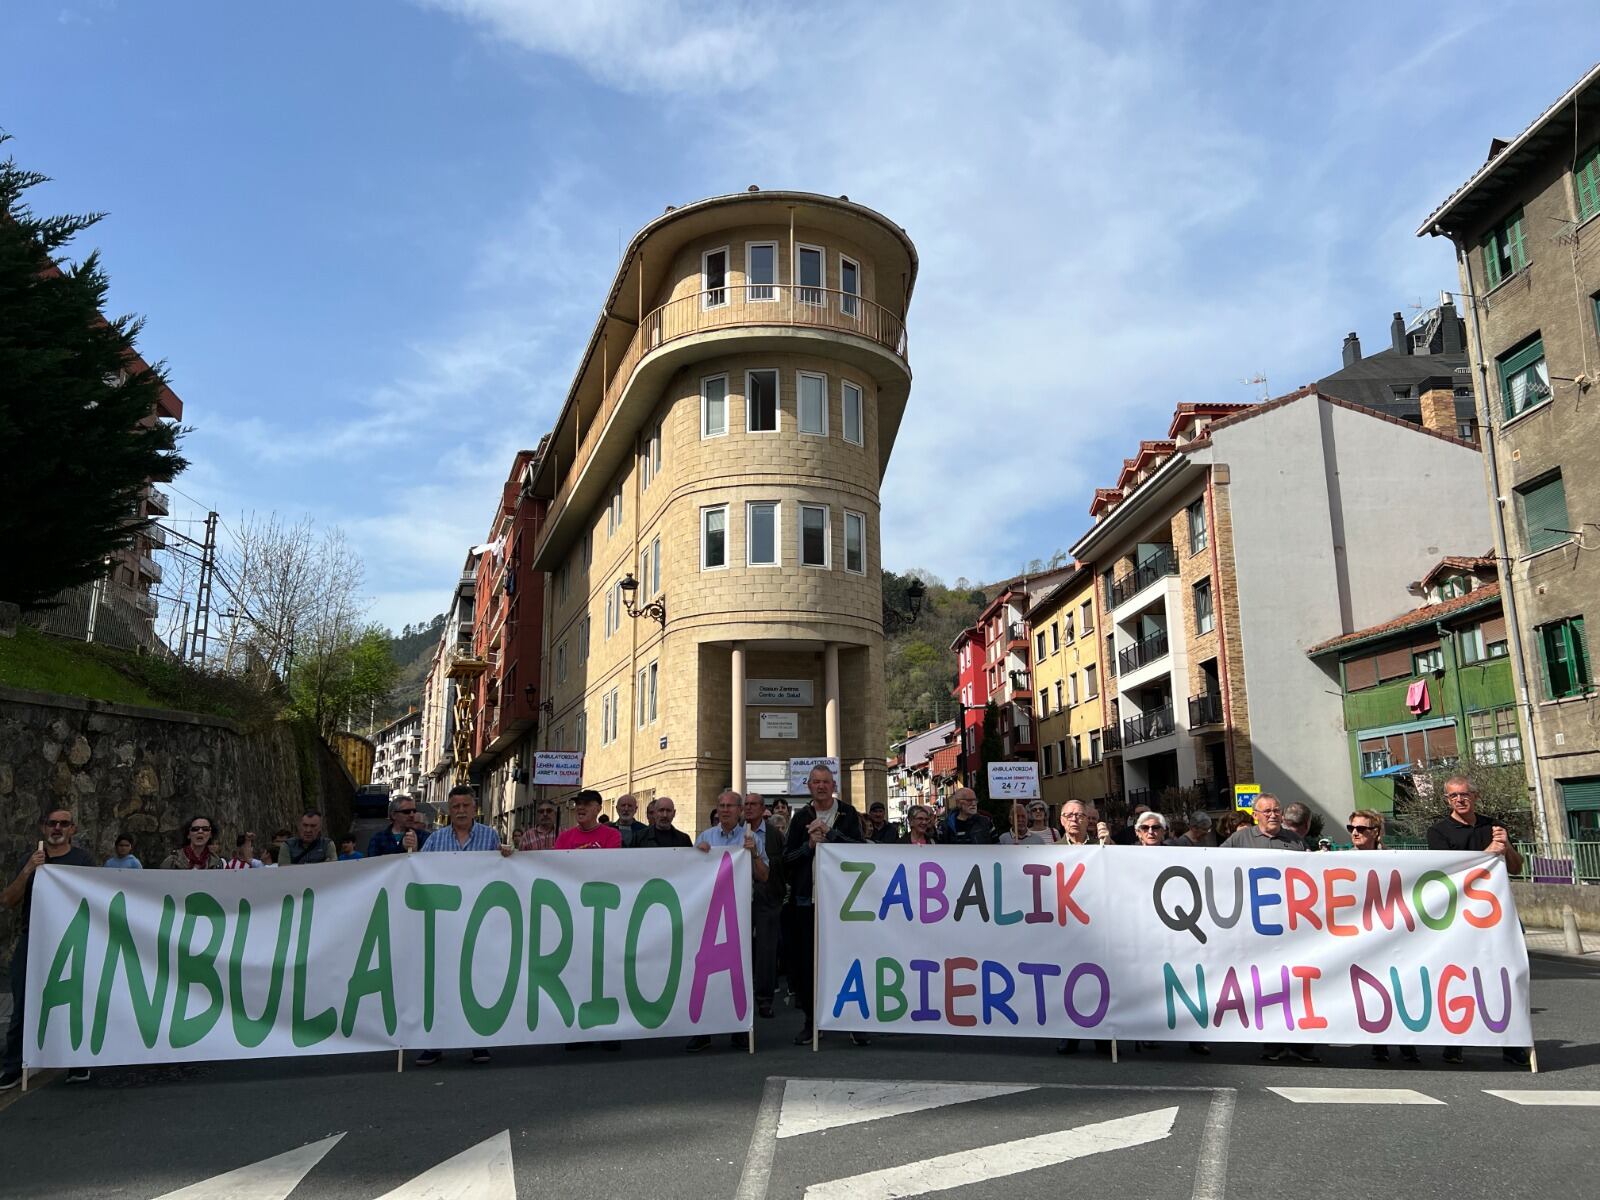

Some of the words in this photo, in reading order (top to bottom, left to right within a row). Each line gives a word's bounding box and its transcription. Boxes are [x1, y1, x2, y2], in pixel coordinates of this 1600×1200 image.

[839, 862, 1090, 926] ZABALIK
[1152, 866, 1503, 944] QUEREMOS
[37, 851, 747, 1056] ANBULATORIOA
[833, 957, 1110, 1028] ABIERTO
[1163, 962, 1328, 1031] NAHI
[1350, 964, 1512, 1034] DUGU
